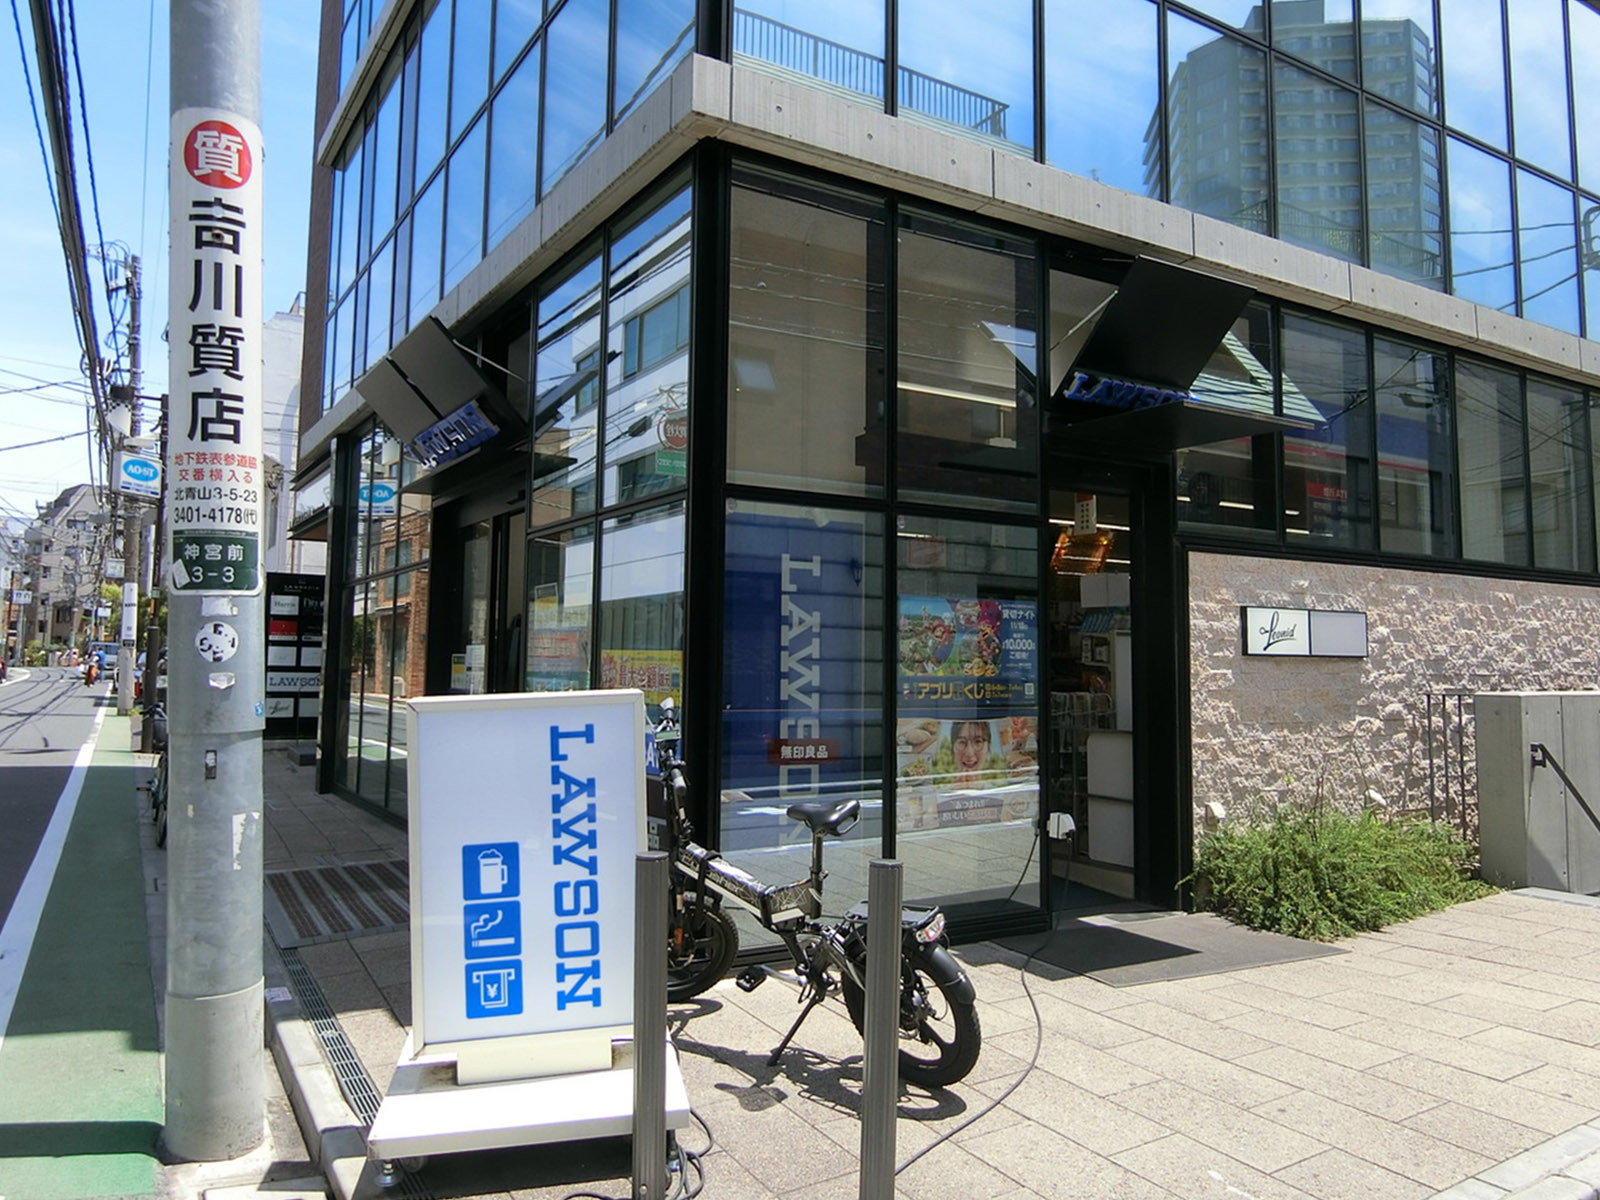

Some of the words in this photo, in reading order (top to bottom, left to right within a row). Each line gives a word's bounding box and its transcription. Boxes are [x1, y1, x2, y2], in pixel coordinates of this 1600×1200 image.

[193, 130, 244, 184] 質
[179, 468, 253, 484] 交番横入る
[174, 486, 258, 503] 北青山3-5-23
[184, 543, 244, 561] 神宮前
[191, 566, 235, 583] 3-3
[780, 744, 829, 760] 無印良品
[549, 723, 602, 1011] LAWSON
